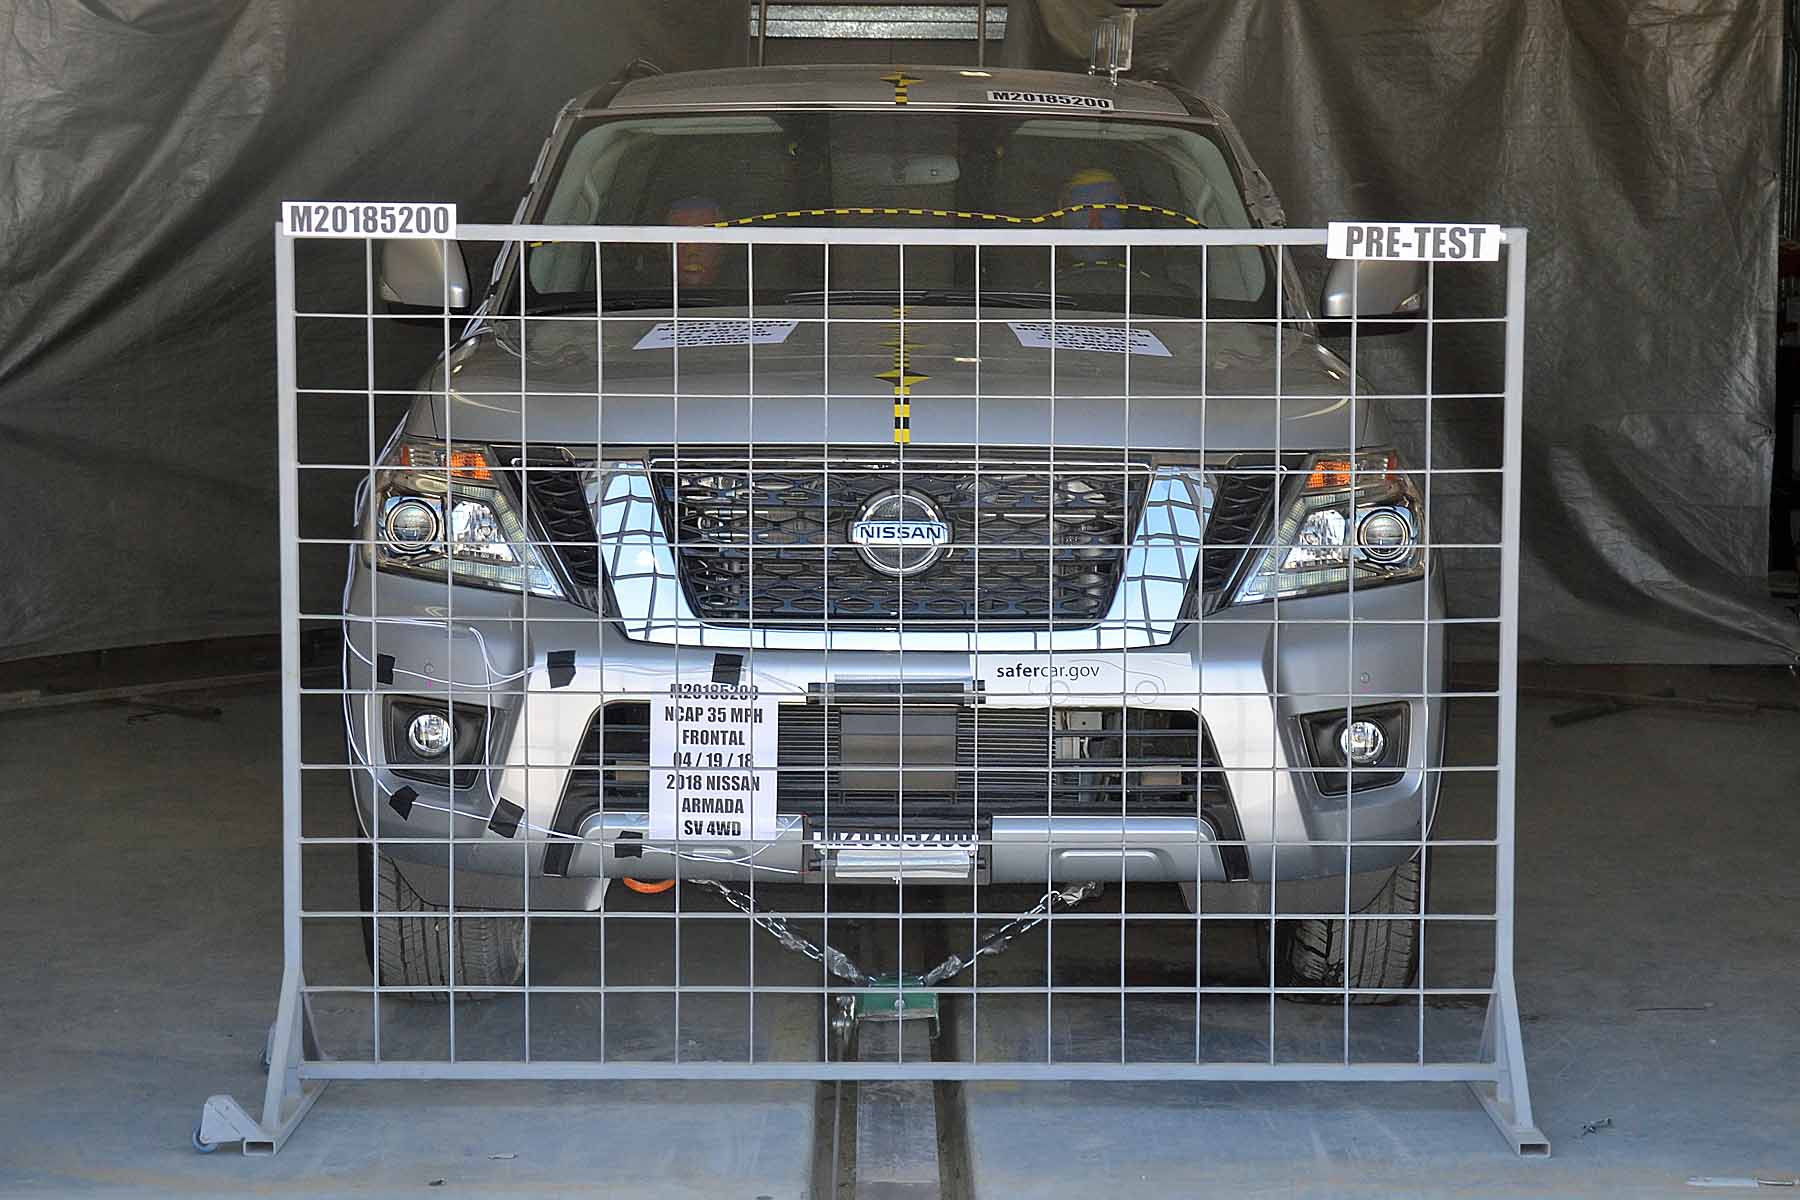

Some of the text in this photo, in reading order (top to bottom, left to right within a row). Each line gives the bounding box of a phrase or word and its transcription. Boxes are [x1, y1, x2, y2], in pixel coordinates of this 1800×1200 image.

[992, 91, 1109, 108] M20185200
[290, 205, 449, 233] M20185200
[1346, 226, 1486, 259] PRE-TEST
[860, 526, 941, 539] NISSAN
[996, 663, 1100, 681] safercar.gov
[664, 706, 763, 724] NCAP 35 MPH
[682, 729, 745, 746] FRONTAL
[673, 752, 692, 768] 04
[695, 752, 703, 768] /
[706, 752, 723, 768] 19
[727, 752, 734, 768] /
[666, 774, 760, 791] 2018 NISSAN
[681, 797, 745, 814] ARMADA
[684, 820, 742, 836] SV 4WD
